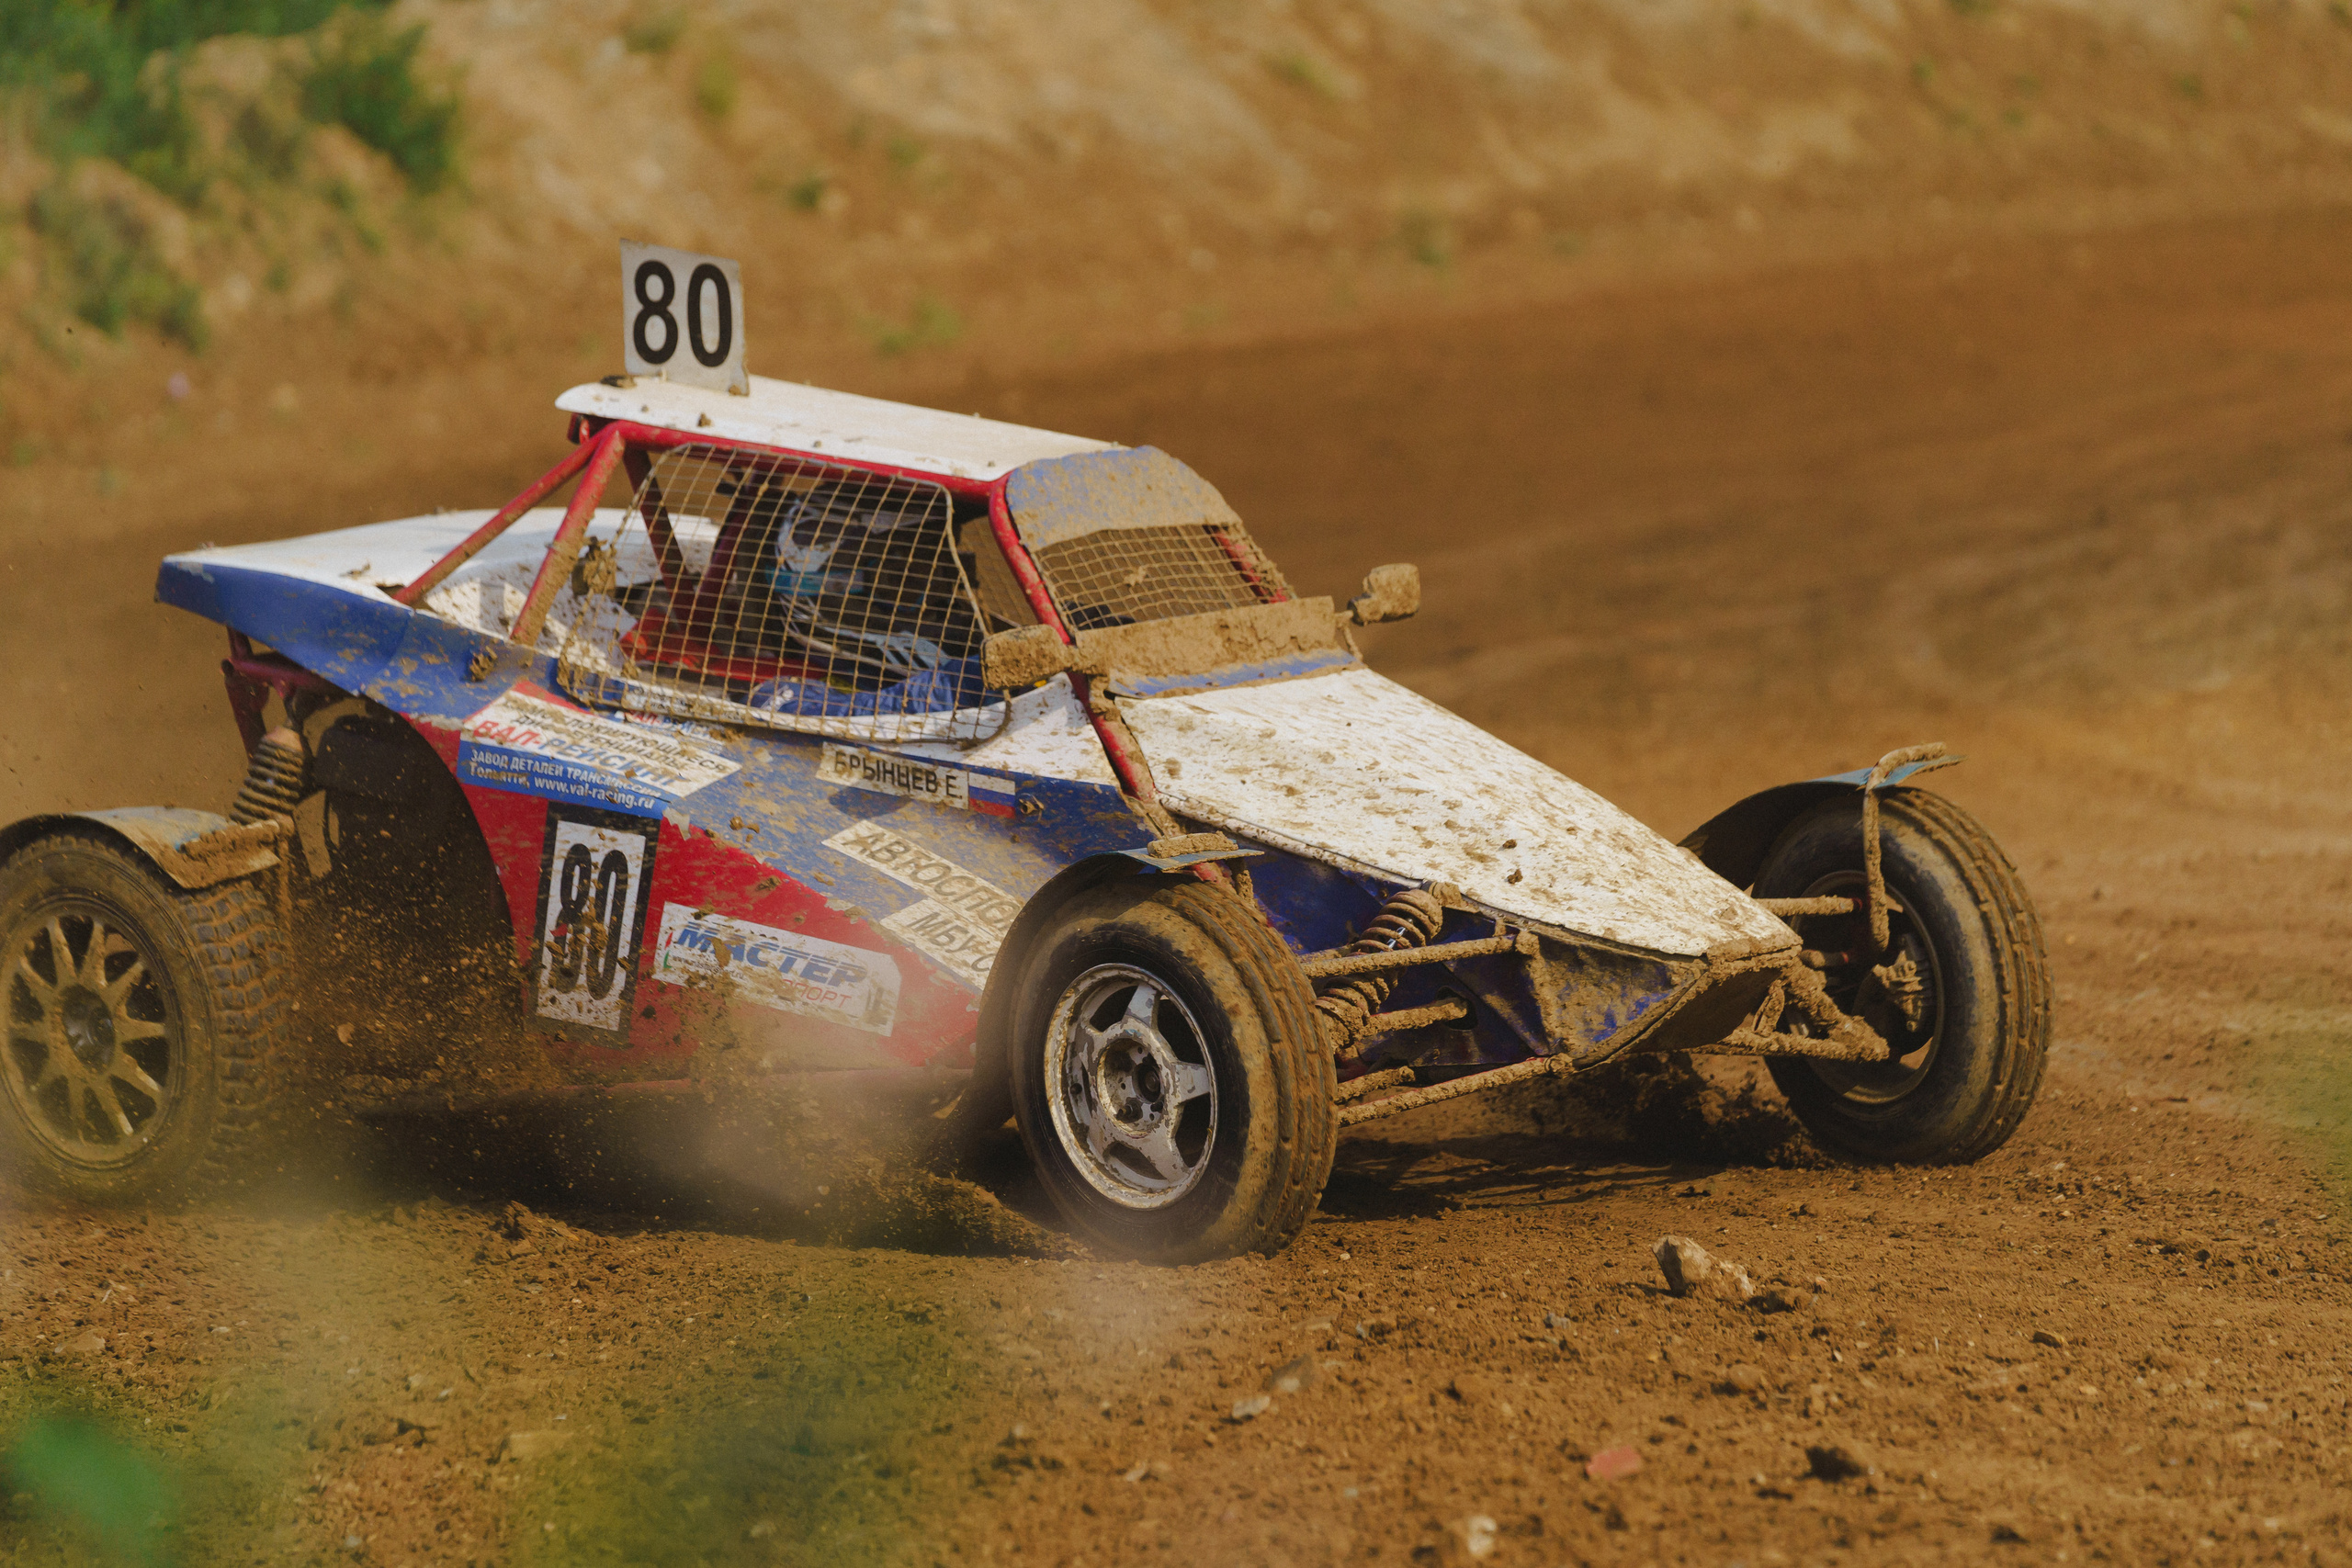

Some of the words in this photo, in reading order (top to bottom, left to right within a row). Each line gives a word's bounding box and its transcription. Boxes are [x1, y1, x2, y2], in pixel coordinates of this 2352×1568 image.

[633, 259, 732, 367] 80
[470, 749, 508, 769] ЗАВОД
[510, 756, 563, 776] ДЕТАЛЕЙ
[834, 750, 938, 793] БРЫНЦЕВ
[945, 774, 963, 799] Е.
[534, 775, 655, 809] www.val-racing.ru
[842, 831, 1022, 931] АВТОСПО
[550, 843, 628, 1000] 80
[905, 911, 976, 953] МБУ
[677, 920, 868, 987] МАСТЕР
